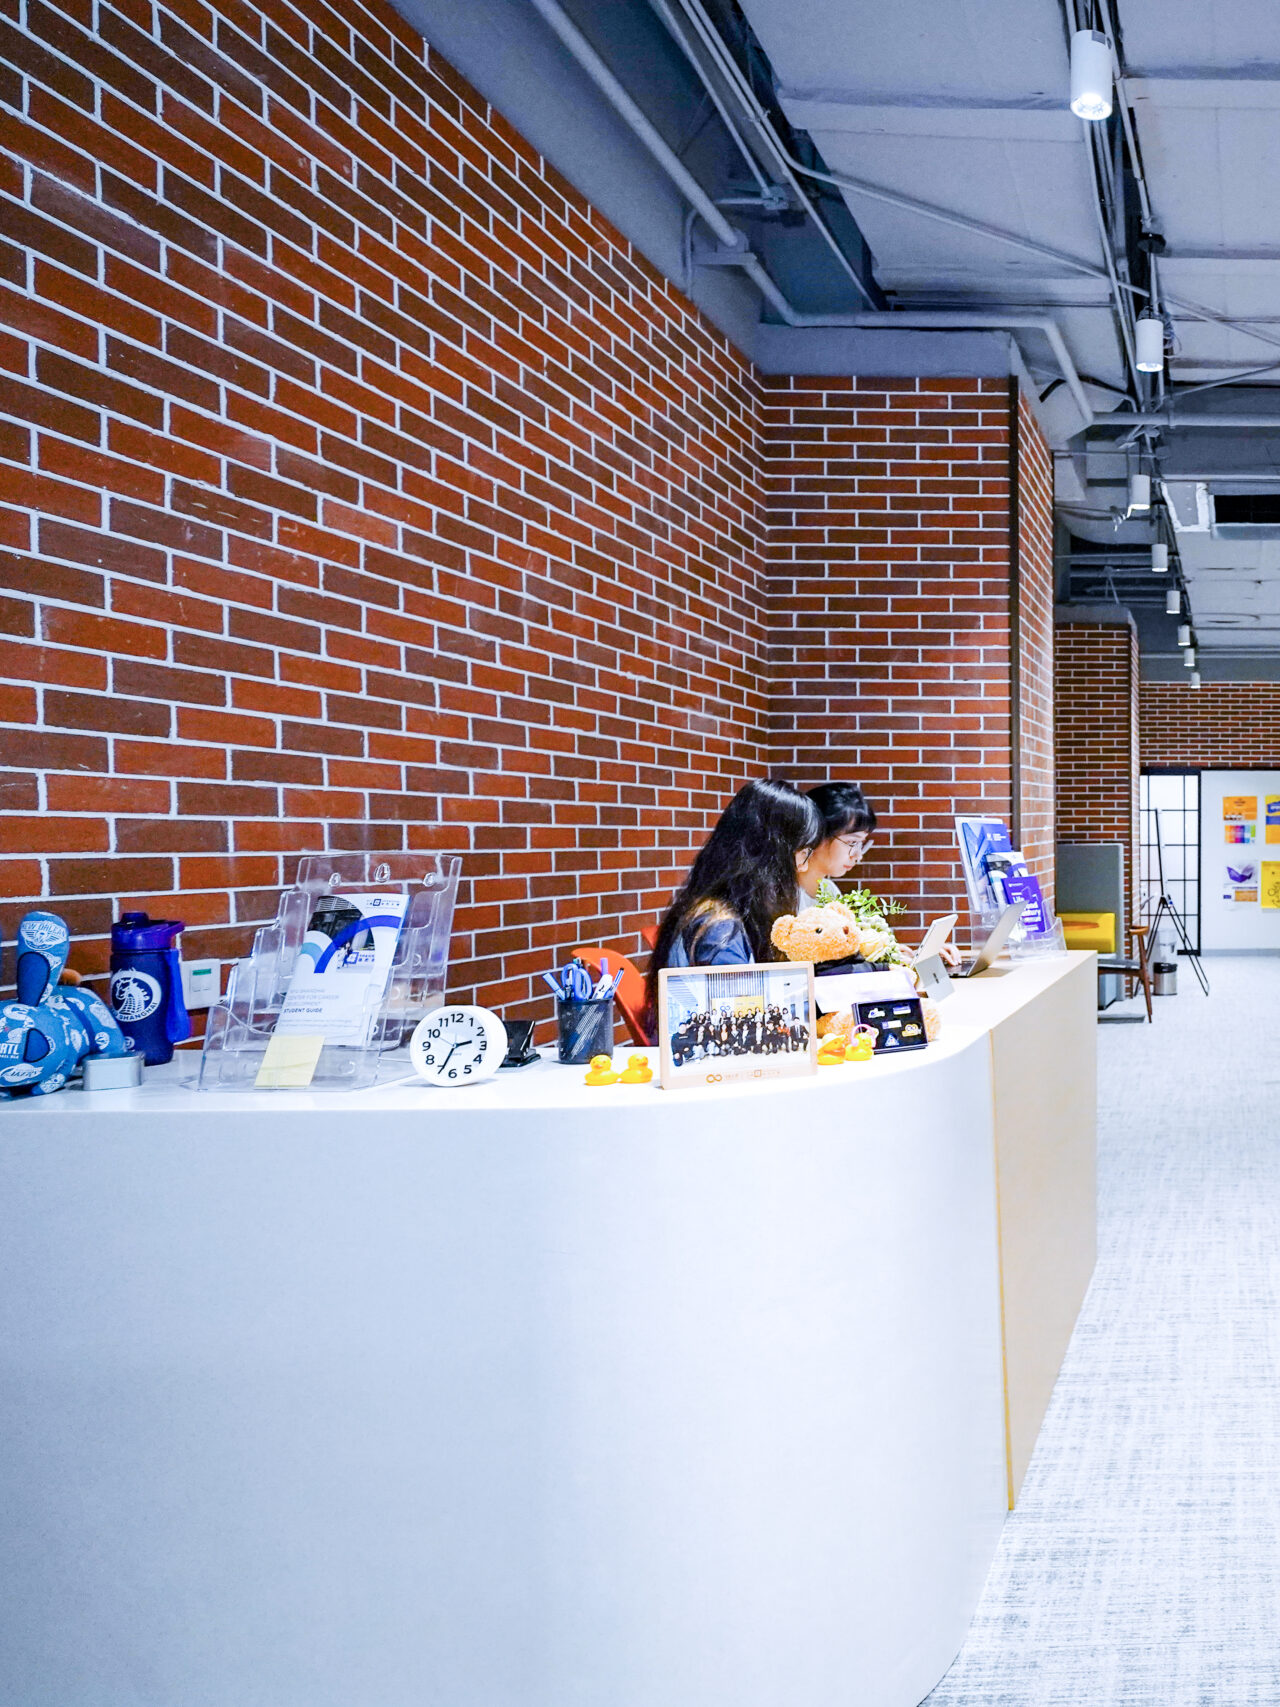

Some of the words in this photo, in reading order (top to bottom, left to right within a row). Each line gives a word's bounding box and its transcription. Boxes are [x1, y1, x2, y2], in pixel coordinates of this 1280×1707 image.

[119, 1002, 158, 1020] SHANGHAI
[438, 1018, 449, 1027] 11
[451, 1012, 464, 1023] 12
[469, 1017, 474, 1027] 1
[427, 1029, 440, 1038] 10
[476, 1026, 485, 1036] 2
[422, 1041, 431, 1051] 9
[479, 1041, 487, 1051] 3
[425, 1054, 435, 1065] 8
[473, 1054, 482, 1064] 4
[437, 1065, 445, 1074] 7
[448, 1068, 457, 1079] 6
[463, 1065, 472, 1074] 5
